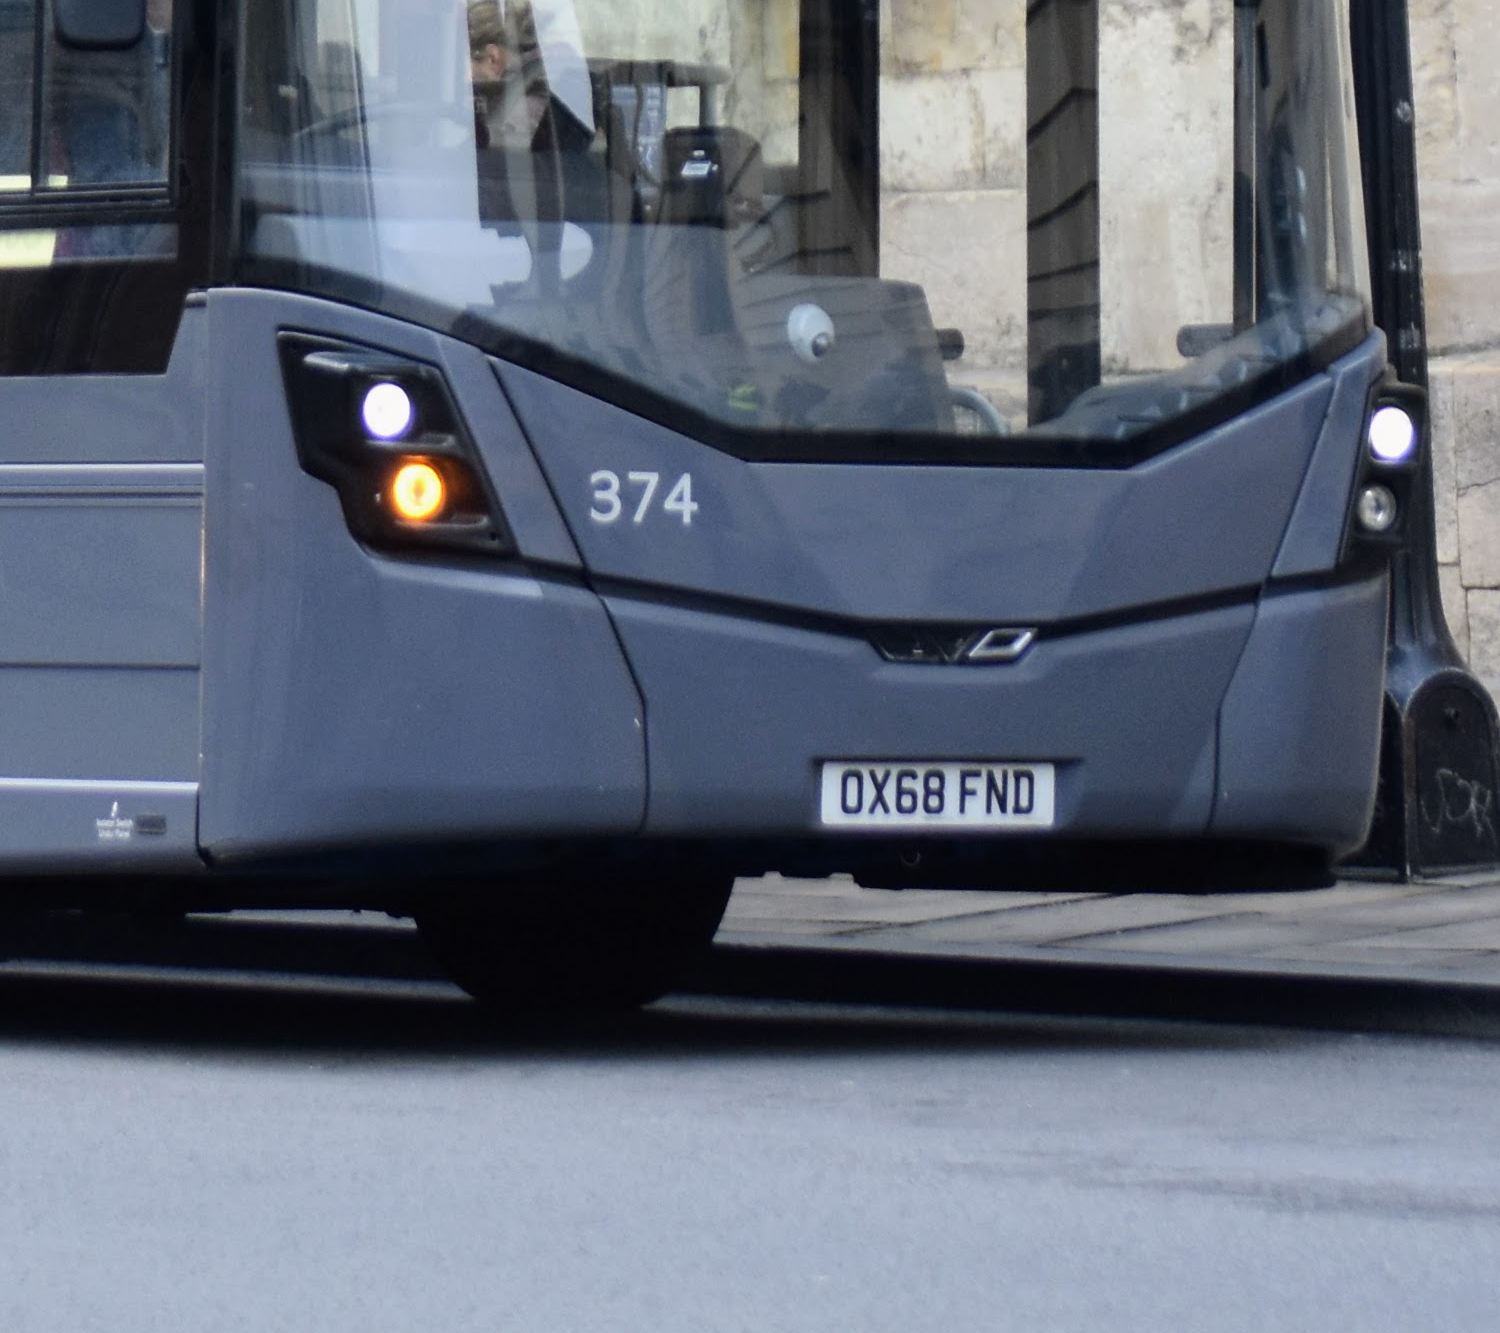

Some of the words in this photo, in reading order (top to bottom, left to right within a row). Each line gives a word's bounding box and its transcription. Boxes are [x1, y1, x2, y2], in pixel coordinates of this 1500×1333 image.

[588, 470, 698, 525] 374
[839, 768, 947, 816] OX68
[958, 769, 1036, 816] FND
